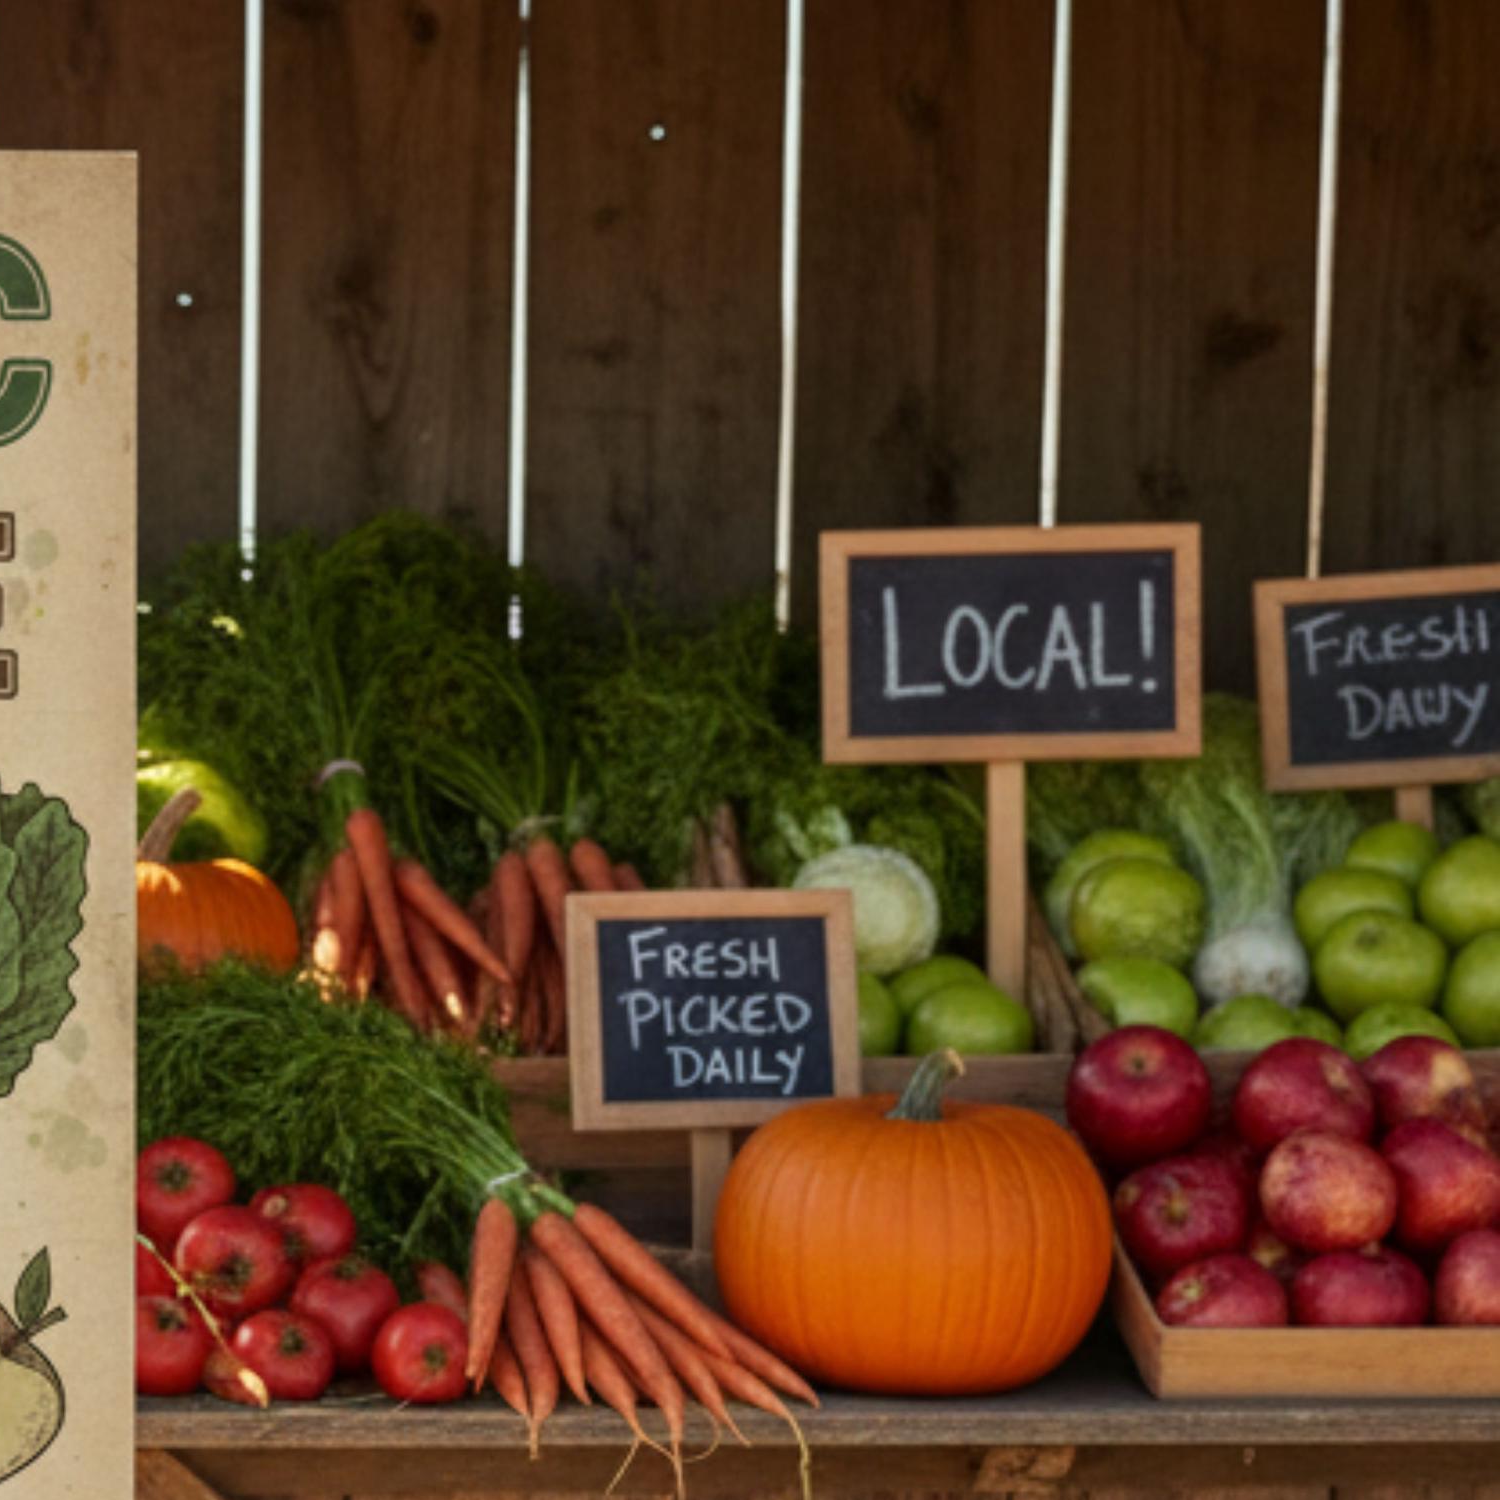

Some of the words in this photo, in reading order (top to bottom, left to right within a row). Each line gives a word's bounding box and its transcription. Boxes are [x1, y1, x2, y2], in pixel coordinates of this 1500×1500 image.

[883, 580, 1157, 698] LOCAL!
[628, 926, 780, 981] FRESH
[617, 988, 812, 1051] PICKED
[666, 1045, 805, 1095] DAILY
